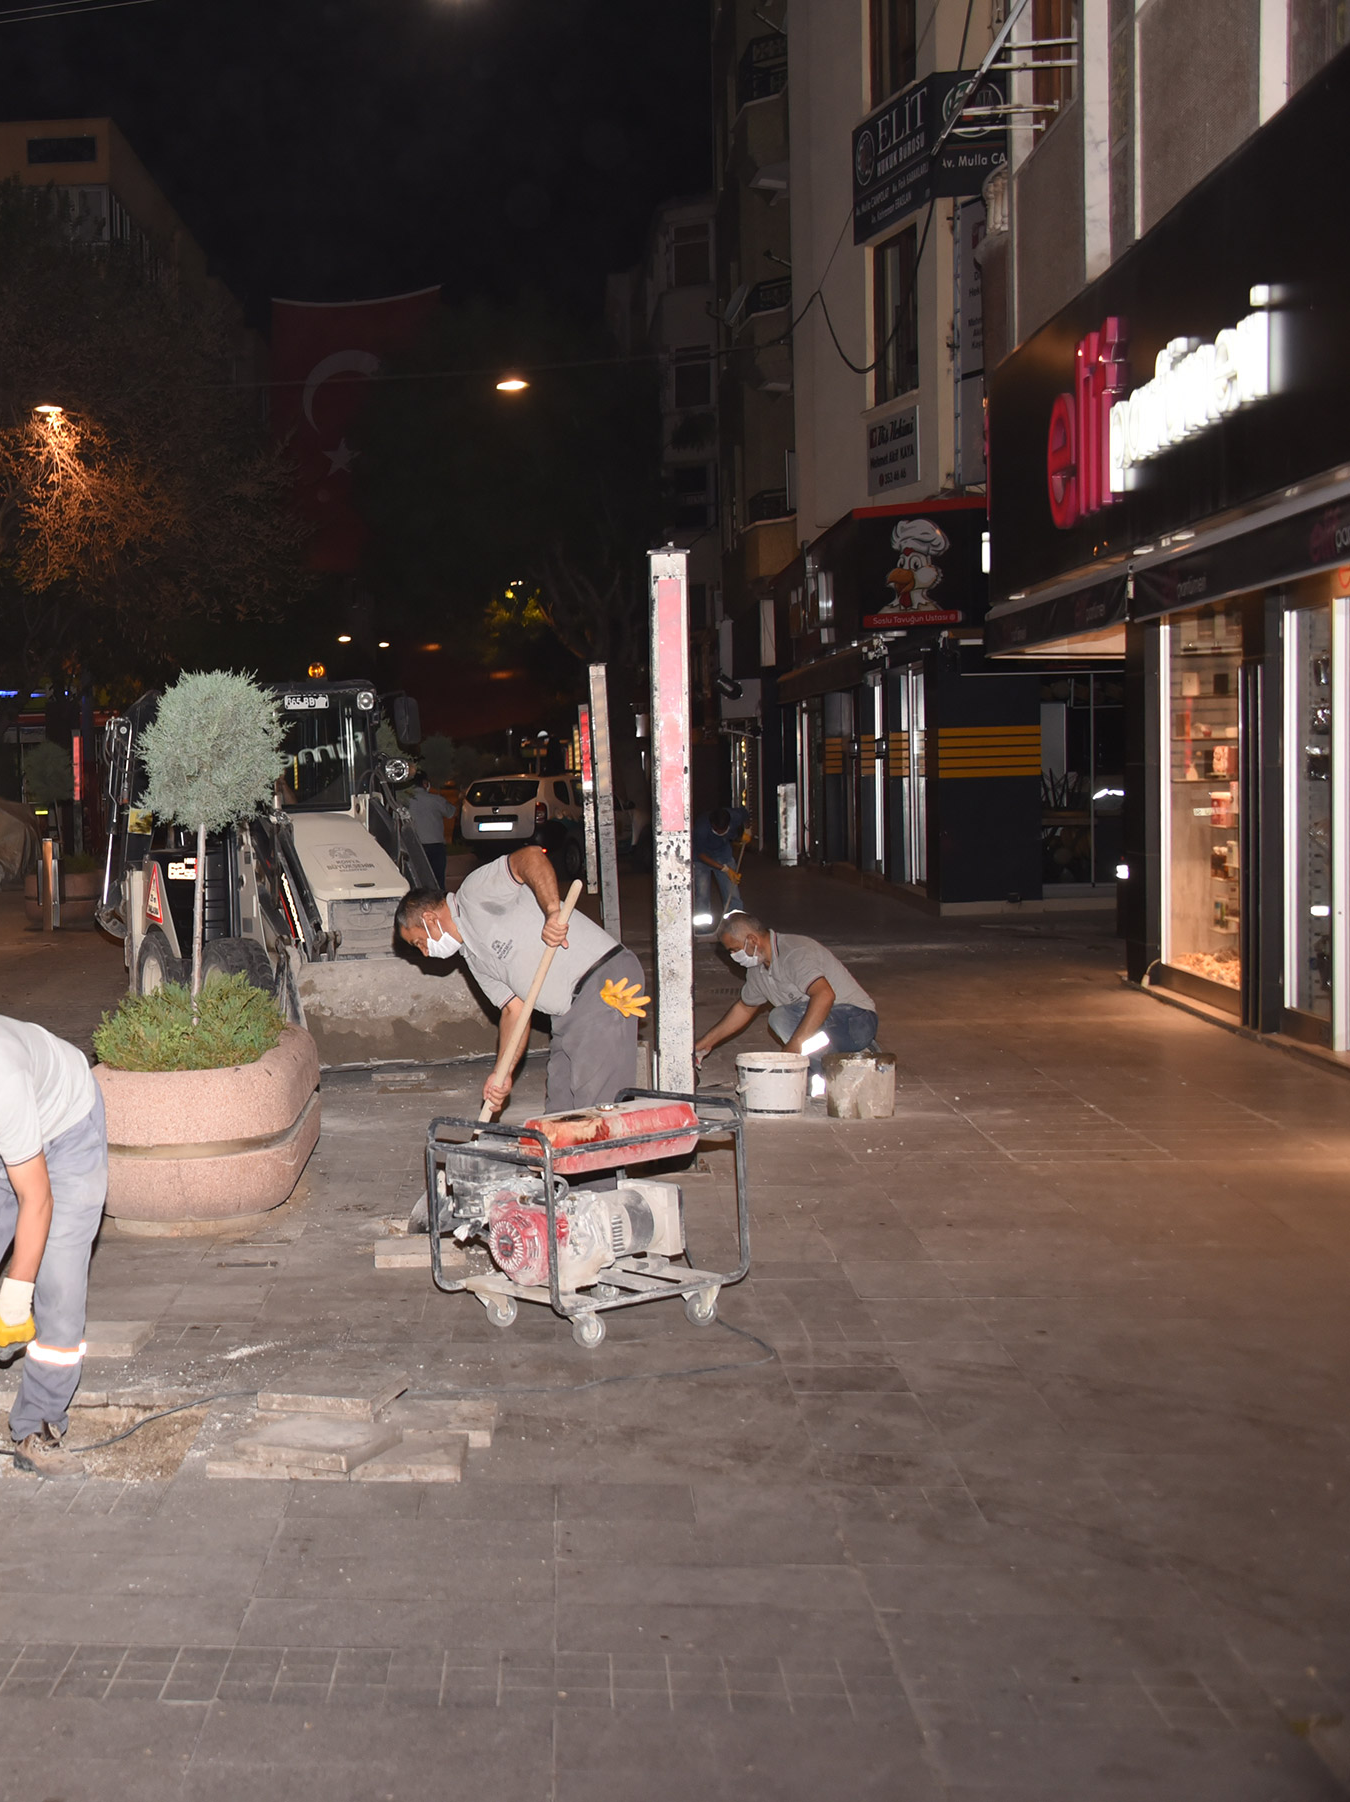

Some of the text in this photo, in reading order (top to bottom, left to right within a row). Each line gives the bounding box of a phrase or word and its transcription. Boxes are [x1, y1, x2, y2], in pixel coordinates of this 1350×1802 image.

[958, 154, 988, 166] Mulla
[1047, 316, 1126, 529] elif
[873, 617, 893, 625] Soslu
[893, 615, 924, 625] Tavuğun
